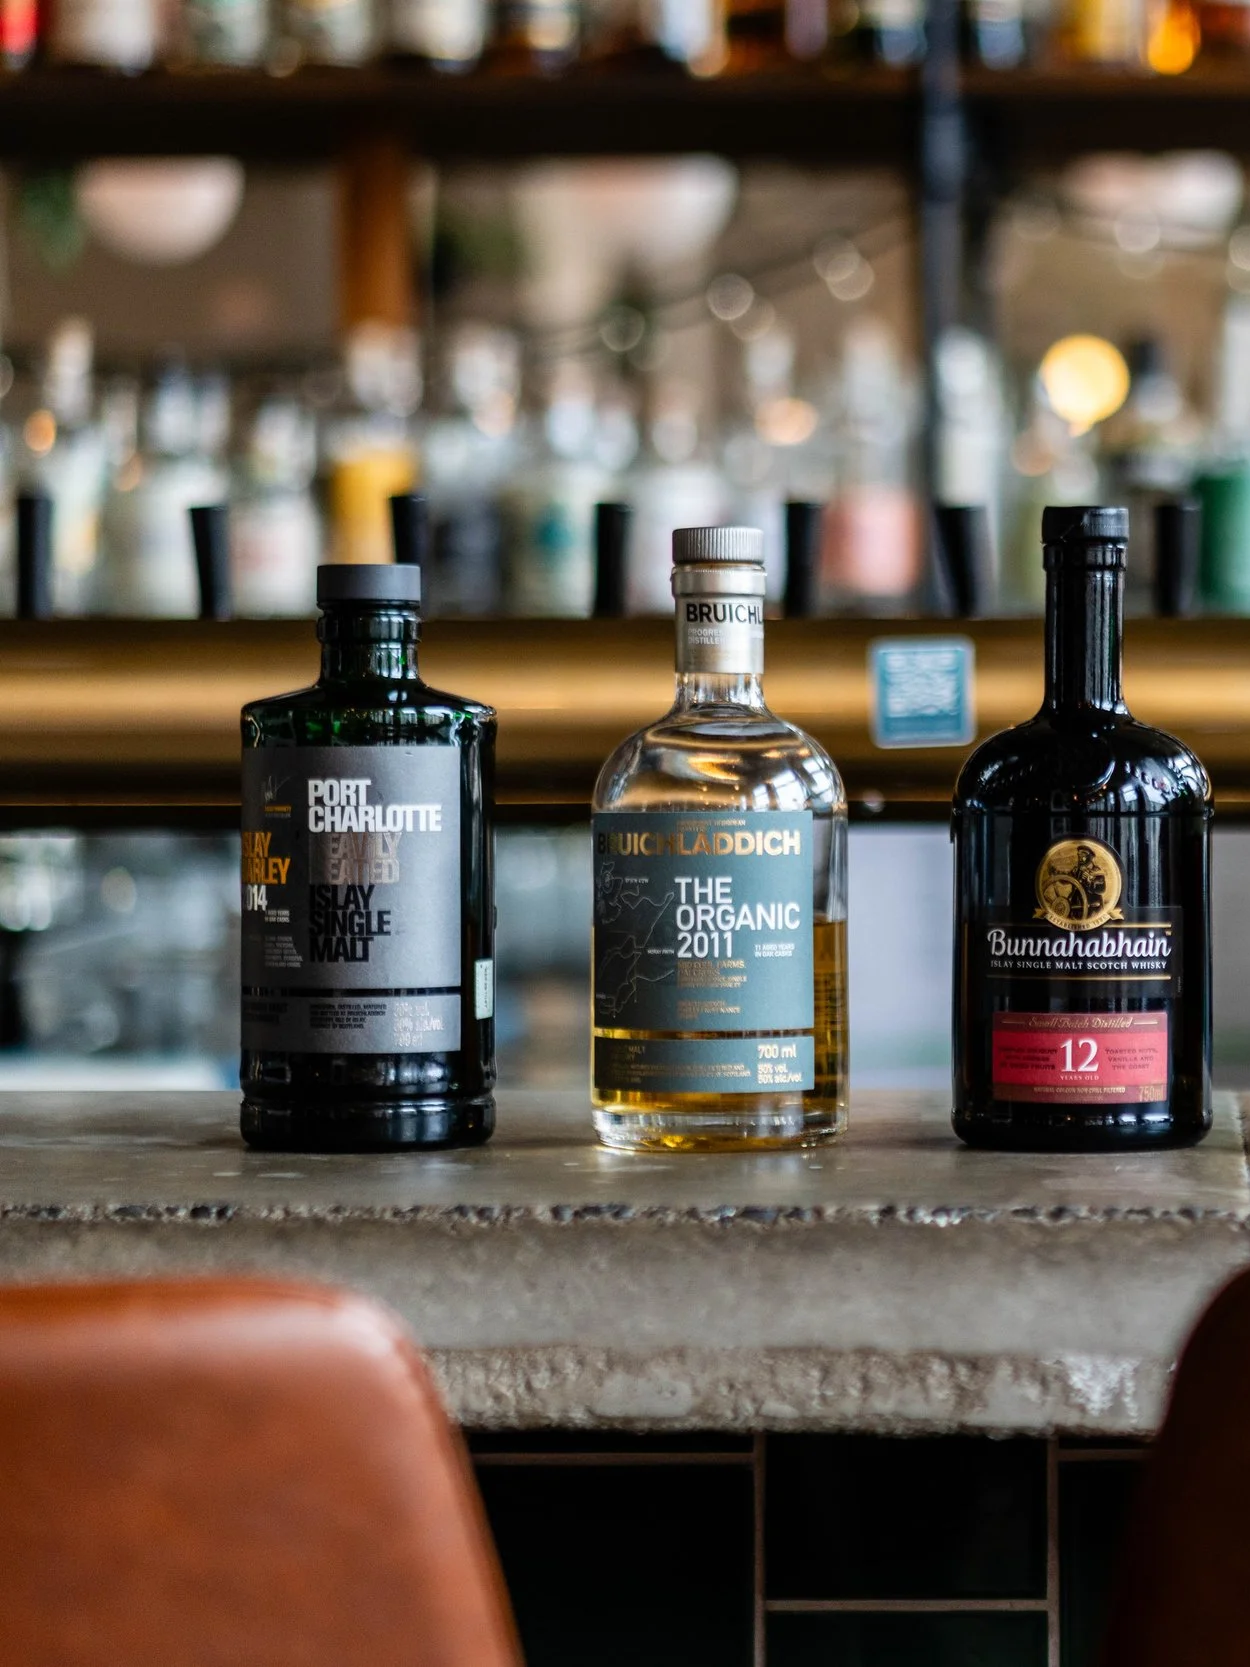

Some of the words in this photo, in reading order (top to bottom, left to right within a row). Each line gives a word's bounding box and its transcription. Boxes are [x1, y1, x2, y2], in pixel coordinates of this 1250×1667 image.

[308, 779, 371, 806] PORT
[308, 804, 442, 833] CHARLOTTE
[598, 830, 801, 856] BRUICHLADDICH
[309, 884, 375, 911] ISLAY
[674, 876, 733, 904] THE
[309, 910, 391, 936] SINGLE
[676, 902, 800, 932] ORGANIC
[309, 936, 374, 962] MALT
[677, 931, 733, 958] 2011
[987, 929, 1172, 958] Bunnahabhain
[1016, 961, 1051, 969] SINGLE
[1055, 961, 1083, 970] MALT
[1087, 961, 1128, 970] SCOTCH
[1131, 961, 1167, 969] WHISKY
[1029, 1016, 1057, 1028] Small
[1058, 1017, 1089, 1028] Batch
[1092, 1017, 1133, 1028] Distilled
[758, 1044, 778, 1058] 700
[781, 1044, 796, 1058] ml
[1060, 1037, 1099, 1072] 12
